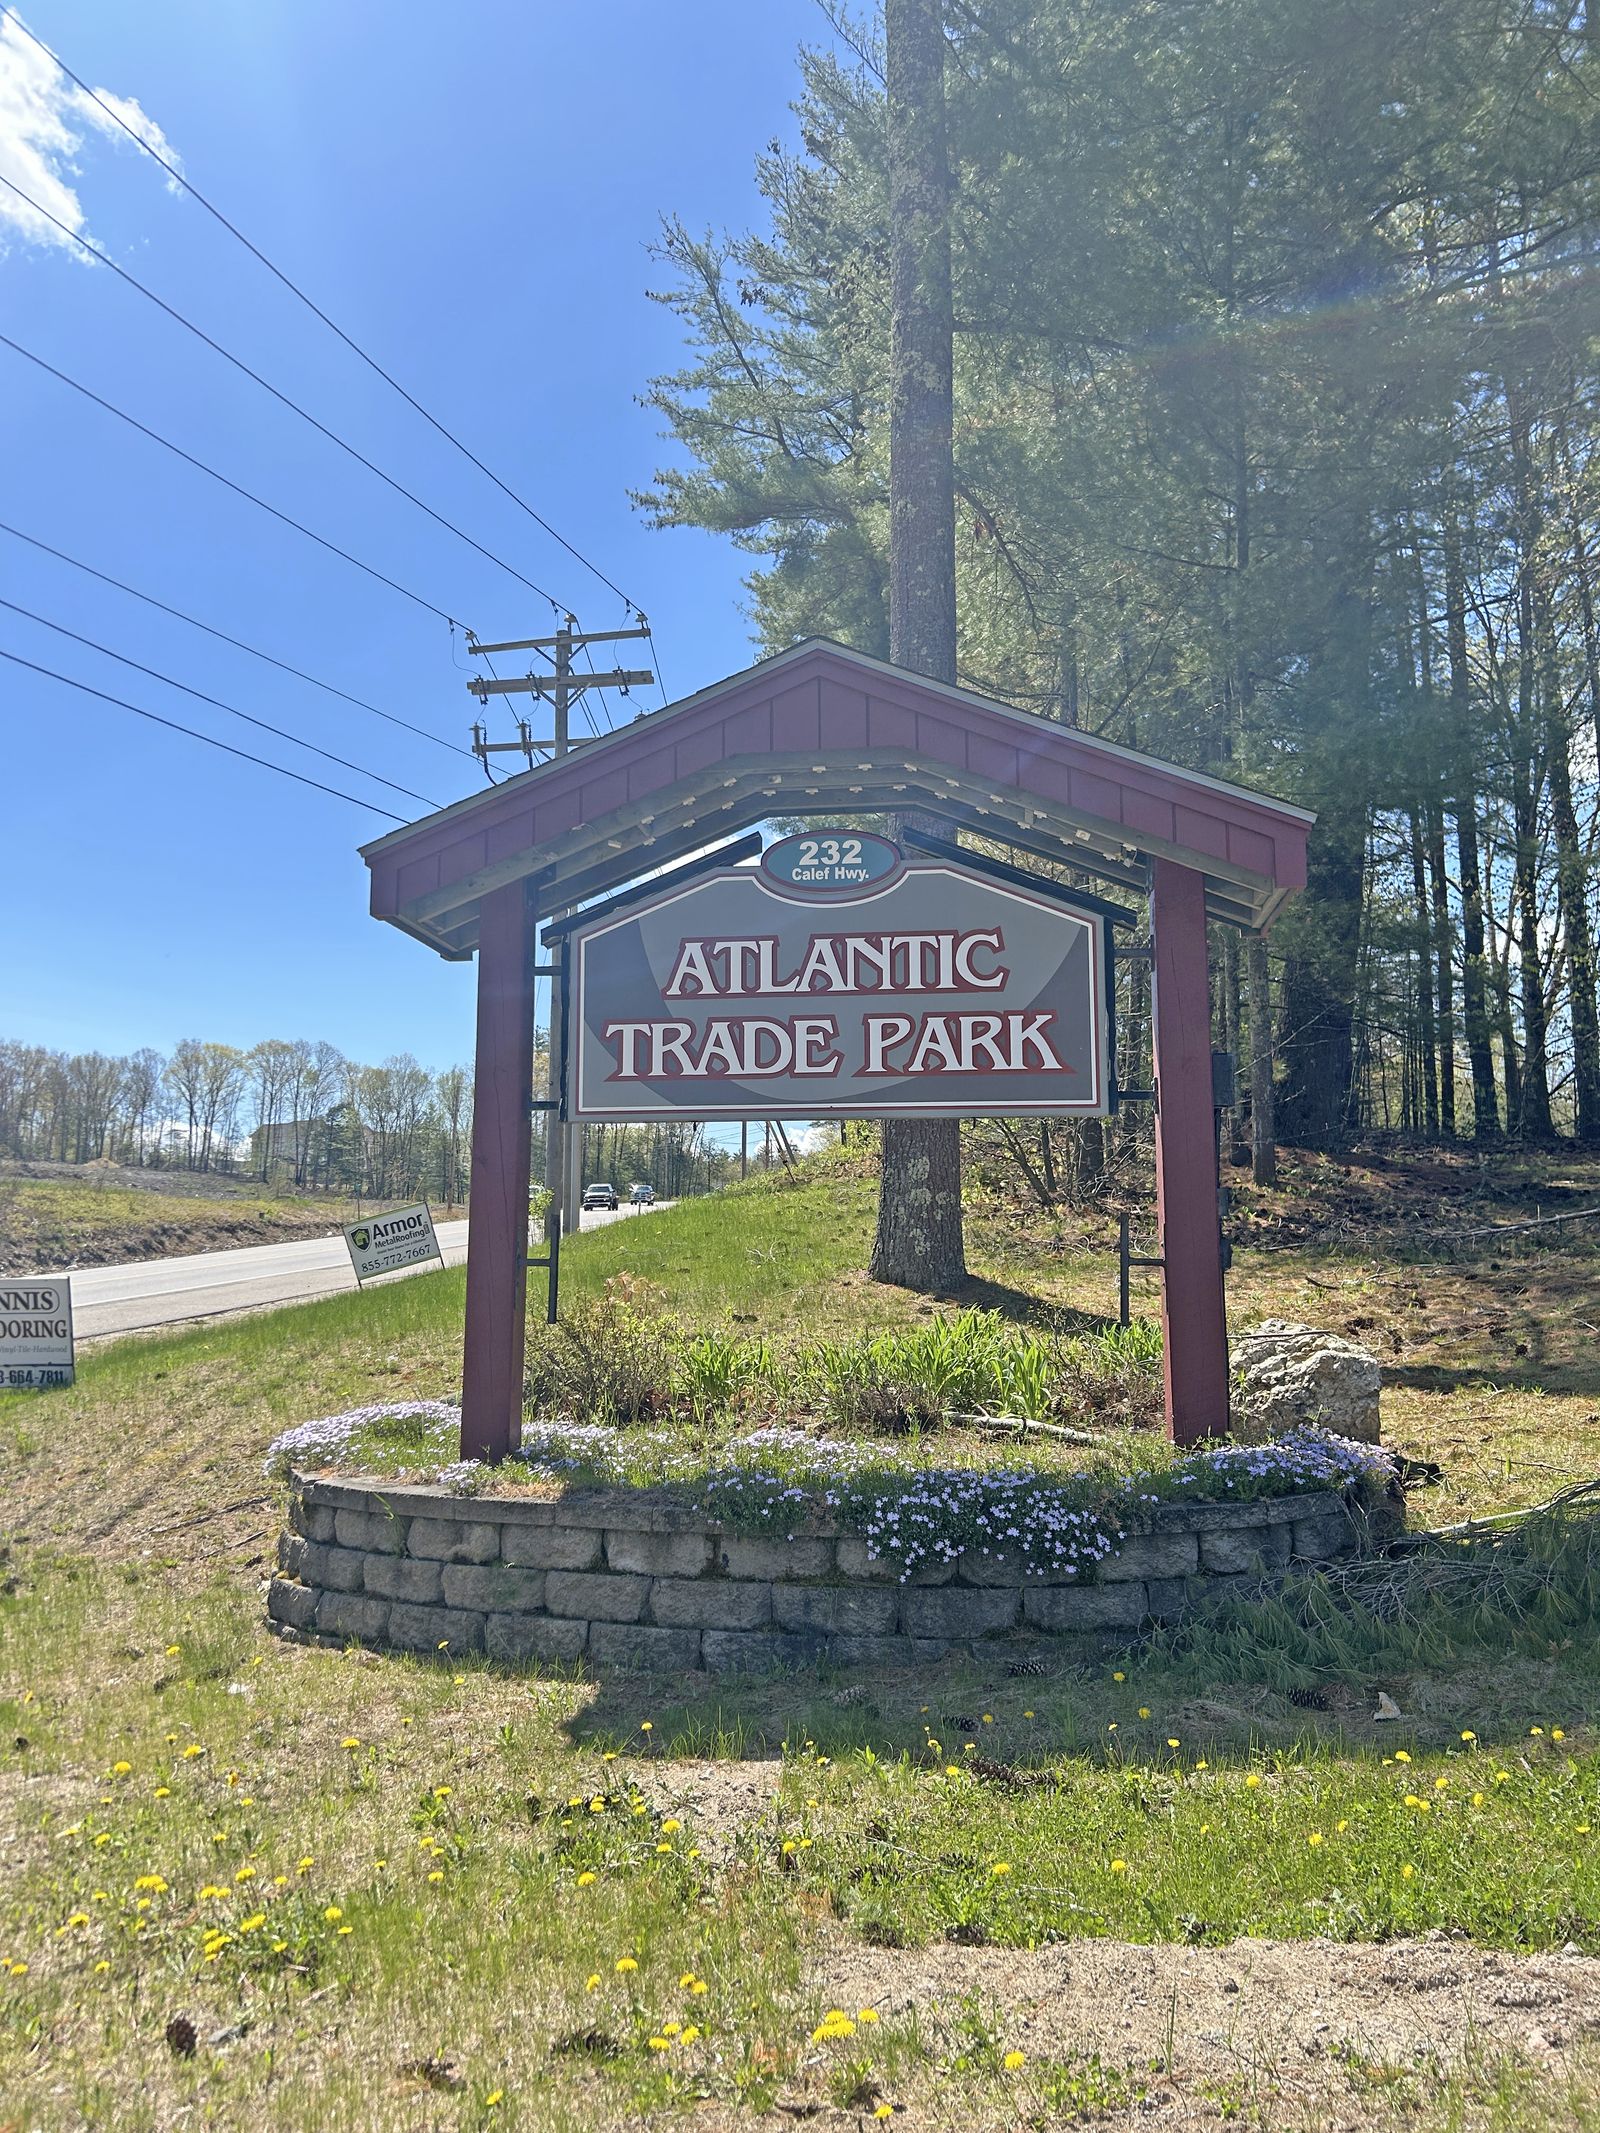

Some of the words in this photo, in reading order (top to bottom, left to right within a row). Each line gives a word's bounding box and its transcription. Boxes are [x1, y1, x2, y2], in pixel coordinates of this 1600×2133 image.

[799, 839, 862, 866] 232
[791, 867, 830, 881] Calef
[834, 866, 870, 882] Hwy.
[663, 929, 1007, 997] ATLANTIC
[604, 1017, 842, 1079] TRADE
[860, 1012, 1068, 1076] PARK
[373, 1213, 423, 1240] Armor
[361, 1244, 431, 1273] 855-772-7667
